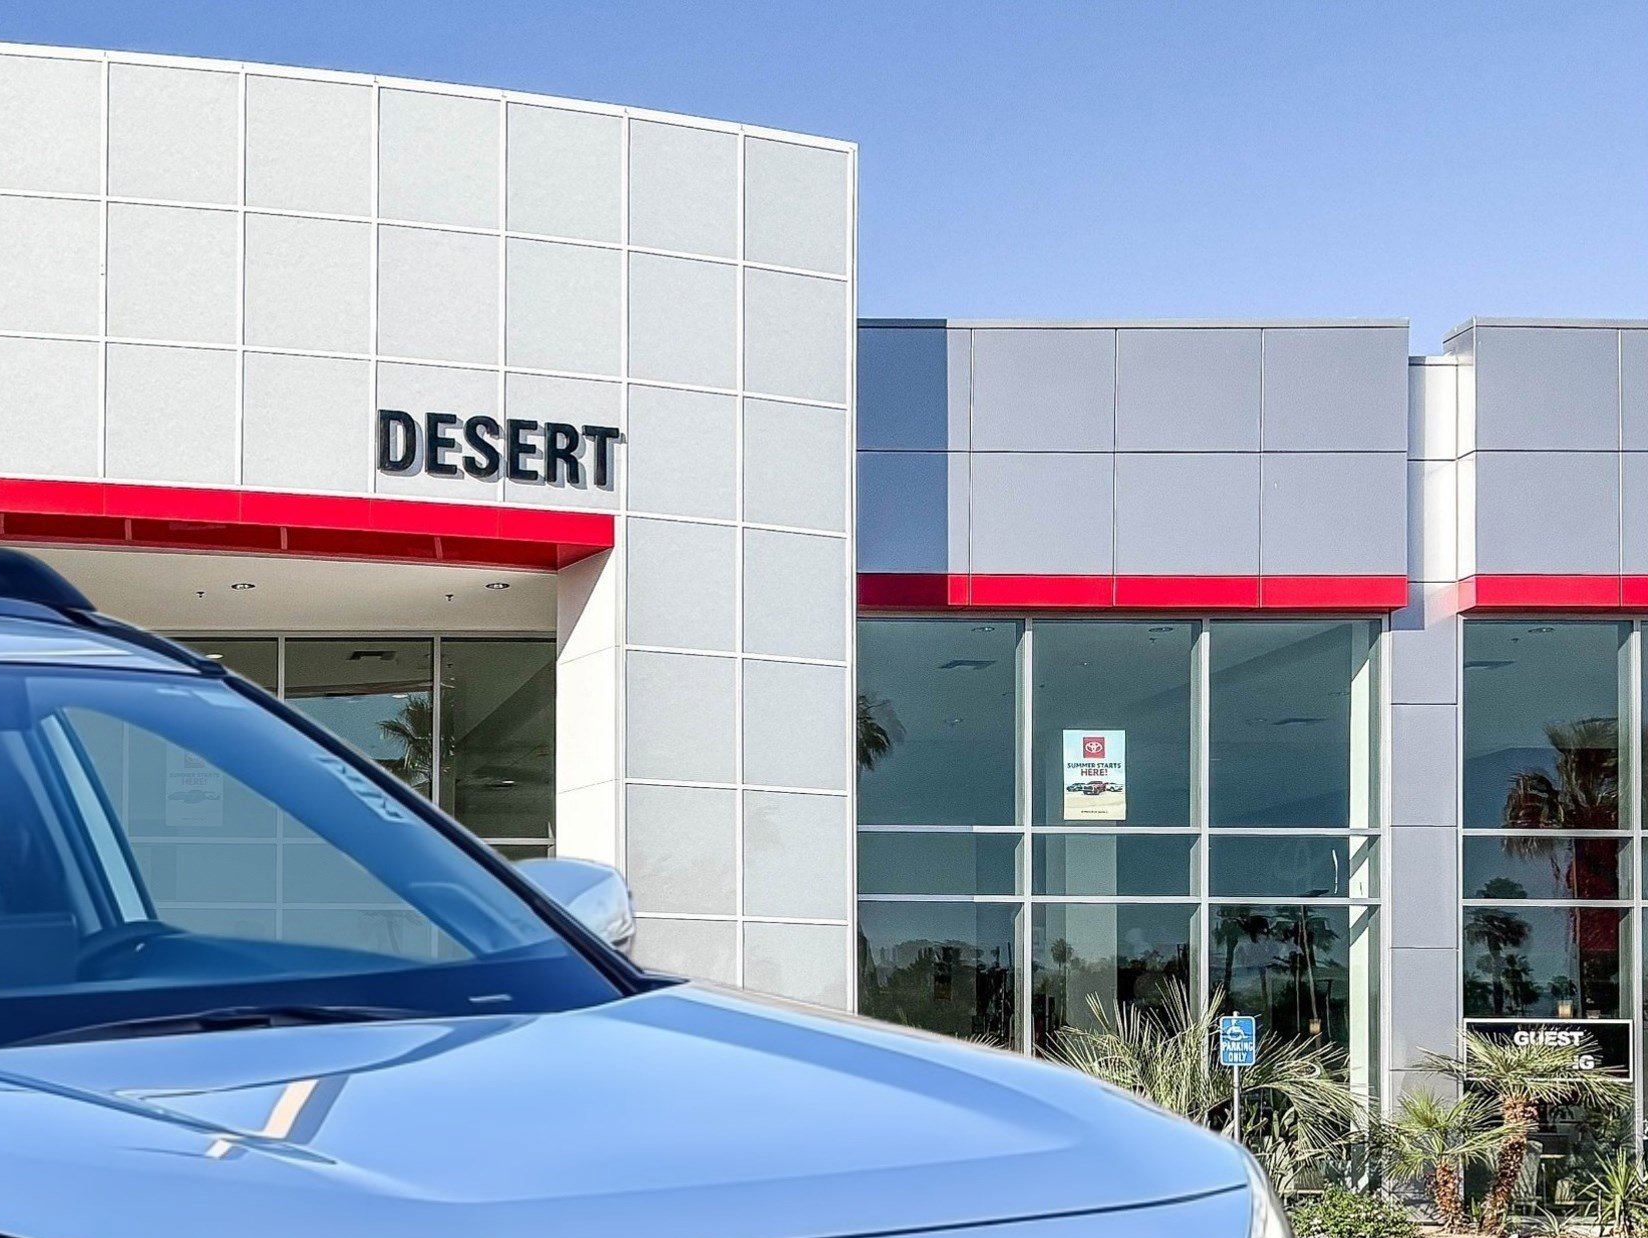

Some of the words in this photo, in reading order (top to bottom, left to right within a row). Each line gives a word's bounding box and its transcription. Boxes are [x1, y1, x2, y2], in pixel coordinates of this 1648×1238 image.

[377, 409, 620, 486] DESERT
[1081, 768, 1108, 776] HERE!
[1513, 1031, 1584, 1046] GUEST
[1222, 1041, 1253, 1051] PARKING
[1228, 1052, 1247, 1062] ONLY
